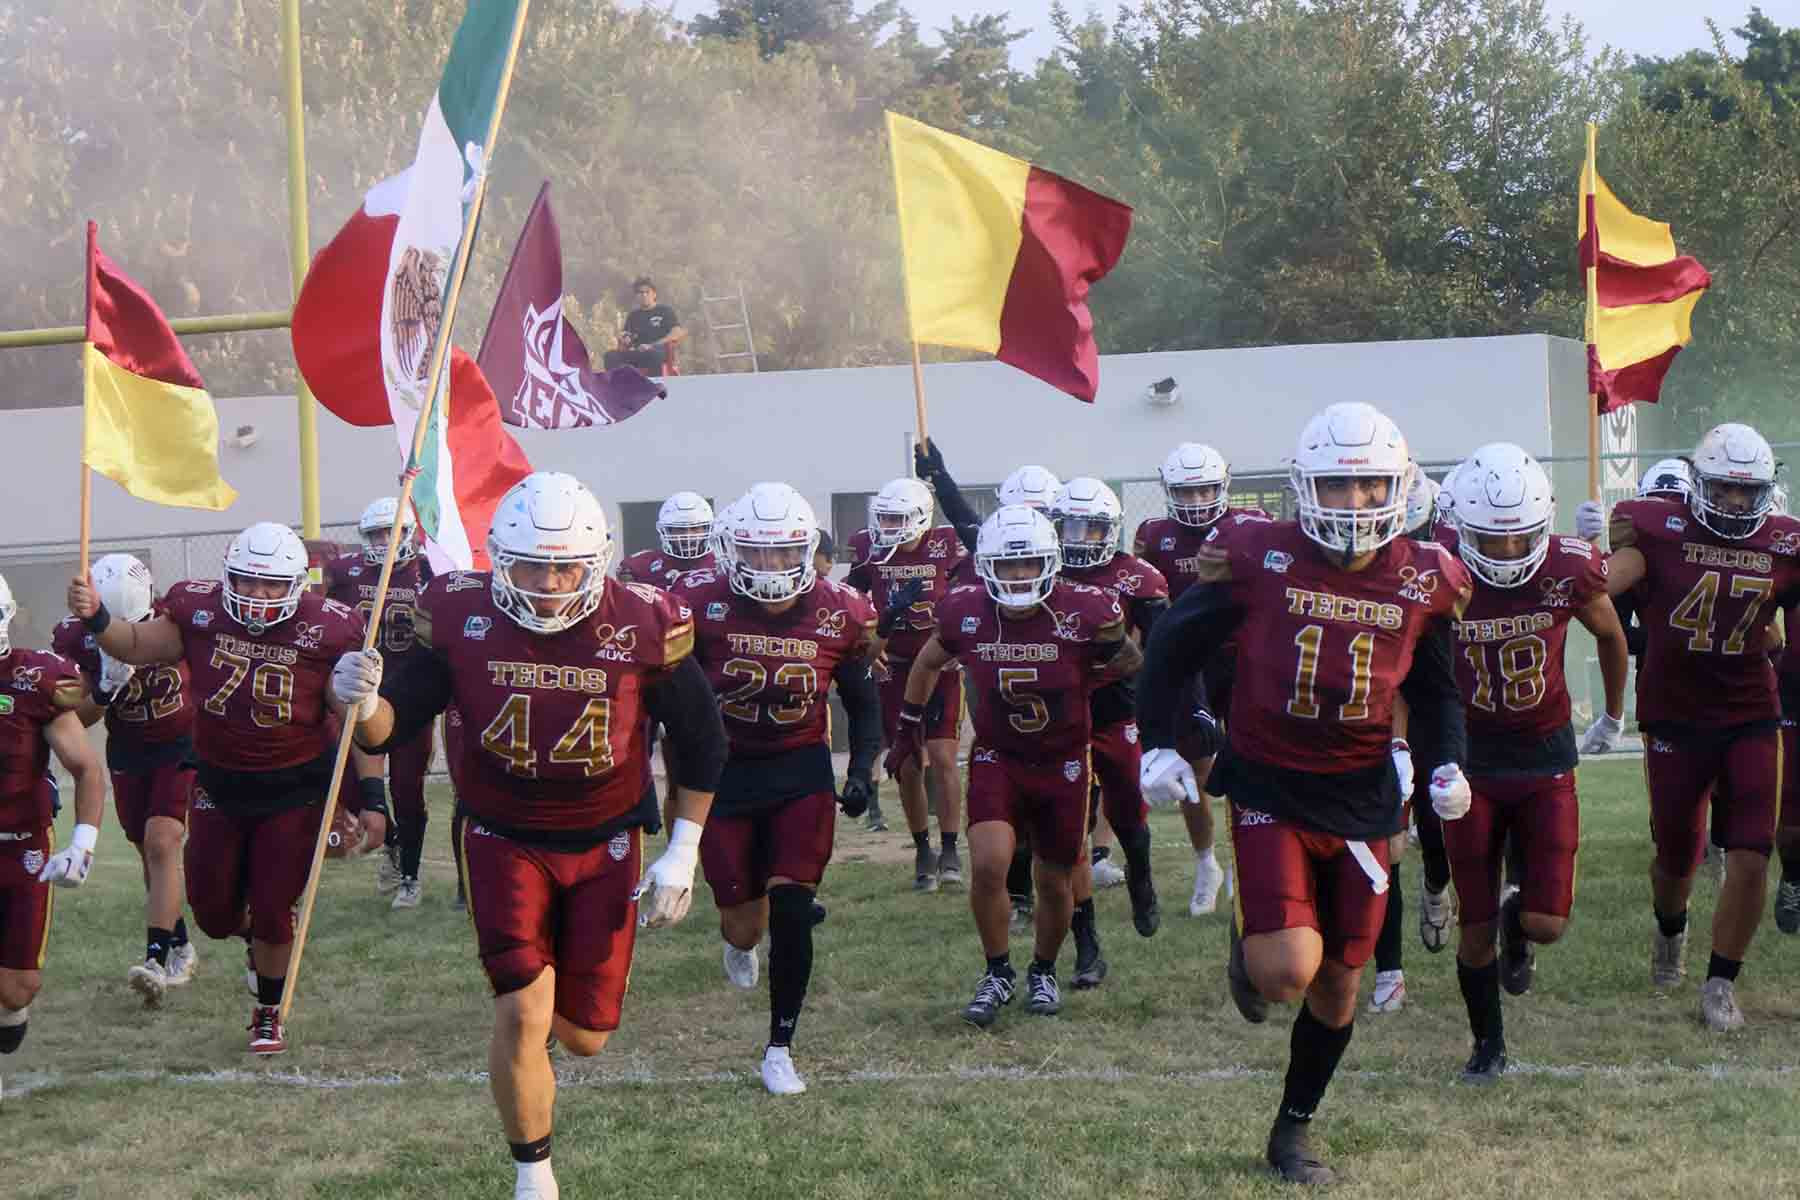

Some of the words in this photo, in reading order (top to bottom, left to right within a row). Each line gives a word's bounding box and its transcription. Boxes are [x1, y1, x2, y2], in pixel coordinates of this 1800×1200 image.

[878, 564, 937, 579] TECOS
[1682, 542, 1774, 573] TECOS
[1286, 587, 1403, 630] TECOS
[1452, 612, 1553, 642] TECOS
[1669, 571, 1774, 655] 47
[216, 632, 298, 665] TECOS
[727, 633, 818, 660] TECOS
[976, 642, 1059, 662] TECOS
[204, 647, 294, 728] 79
[488, 661, 607, 693] TECOS
[720, 657, 817, 724] 23
[1287, 624, 1375, 720] 11
[1464, 634, 1547, 712] 18
[999, 668, 1049, 733] 5
[481, 693, 614, 777] 44
